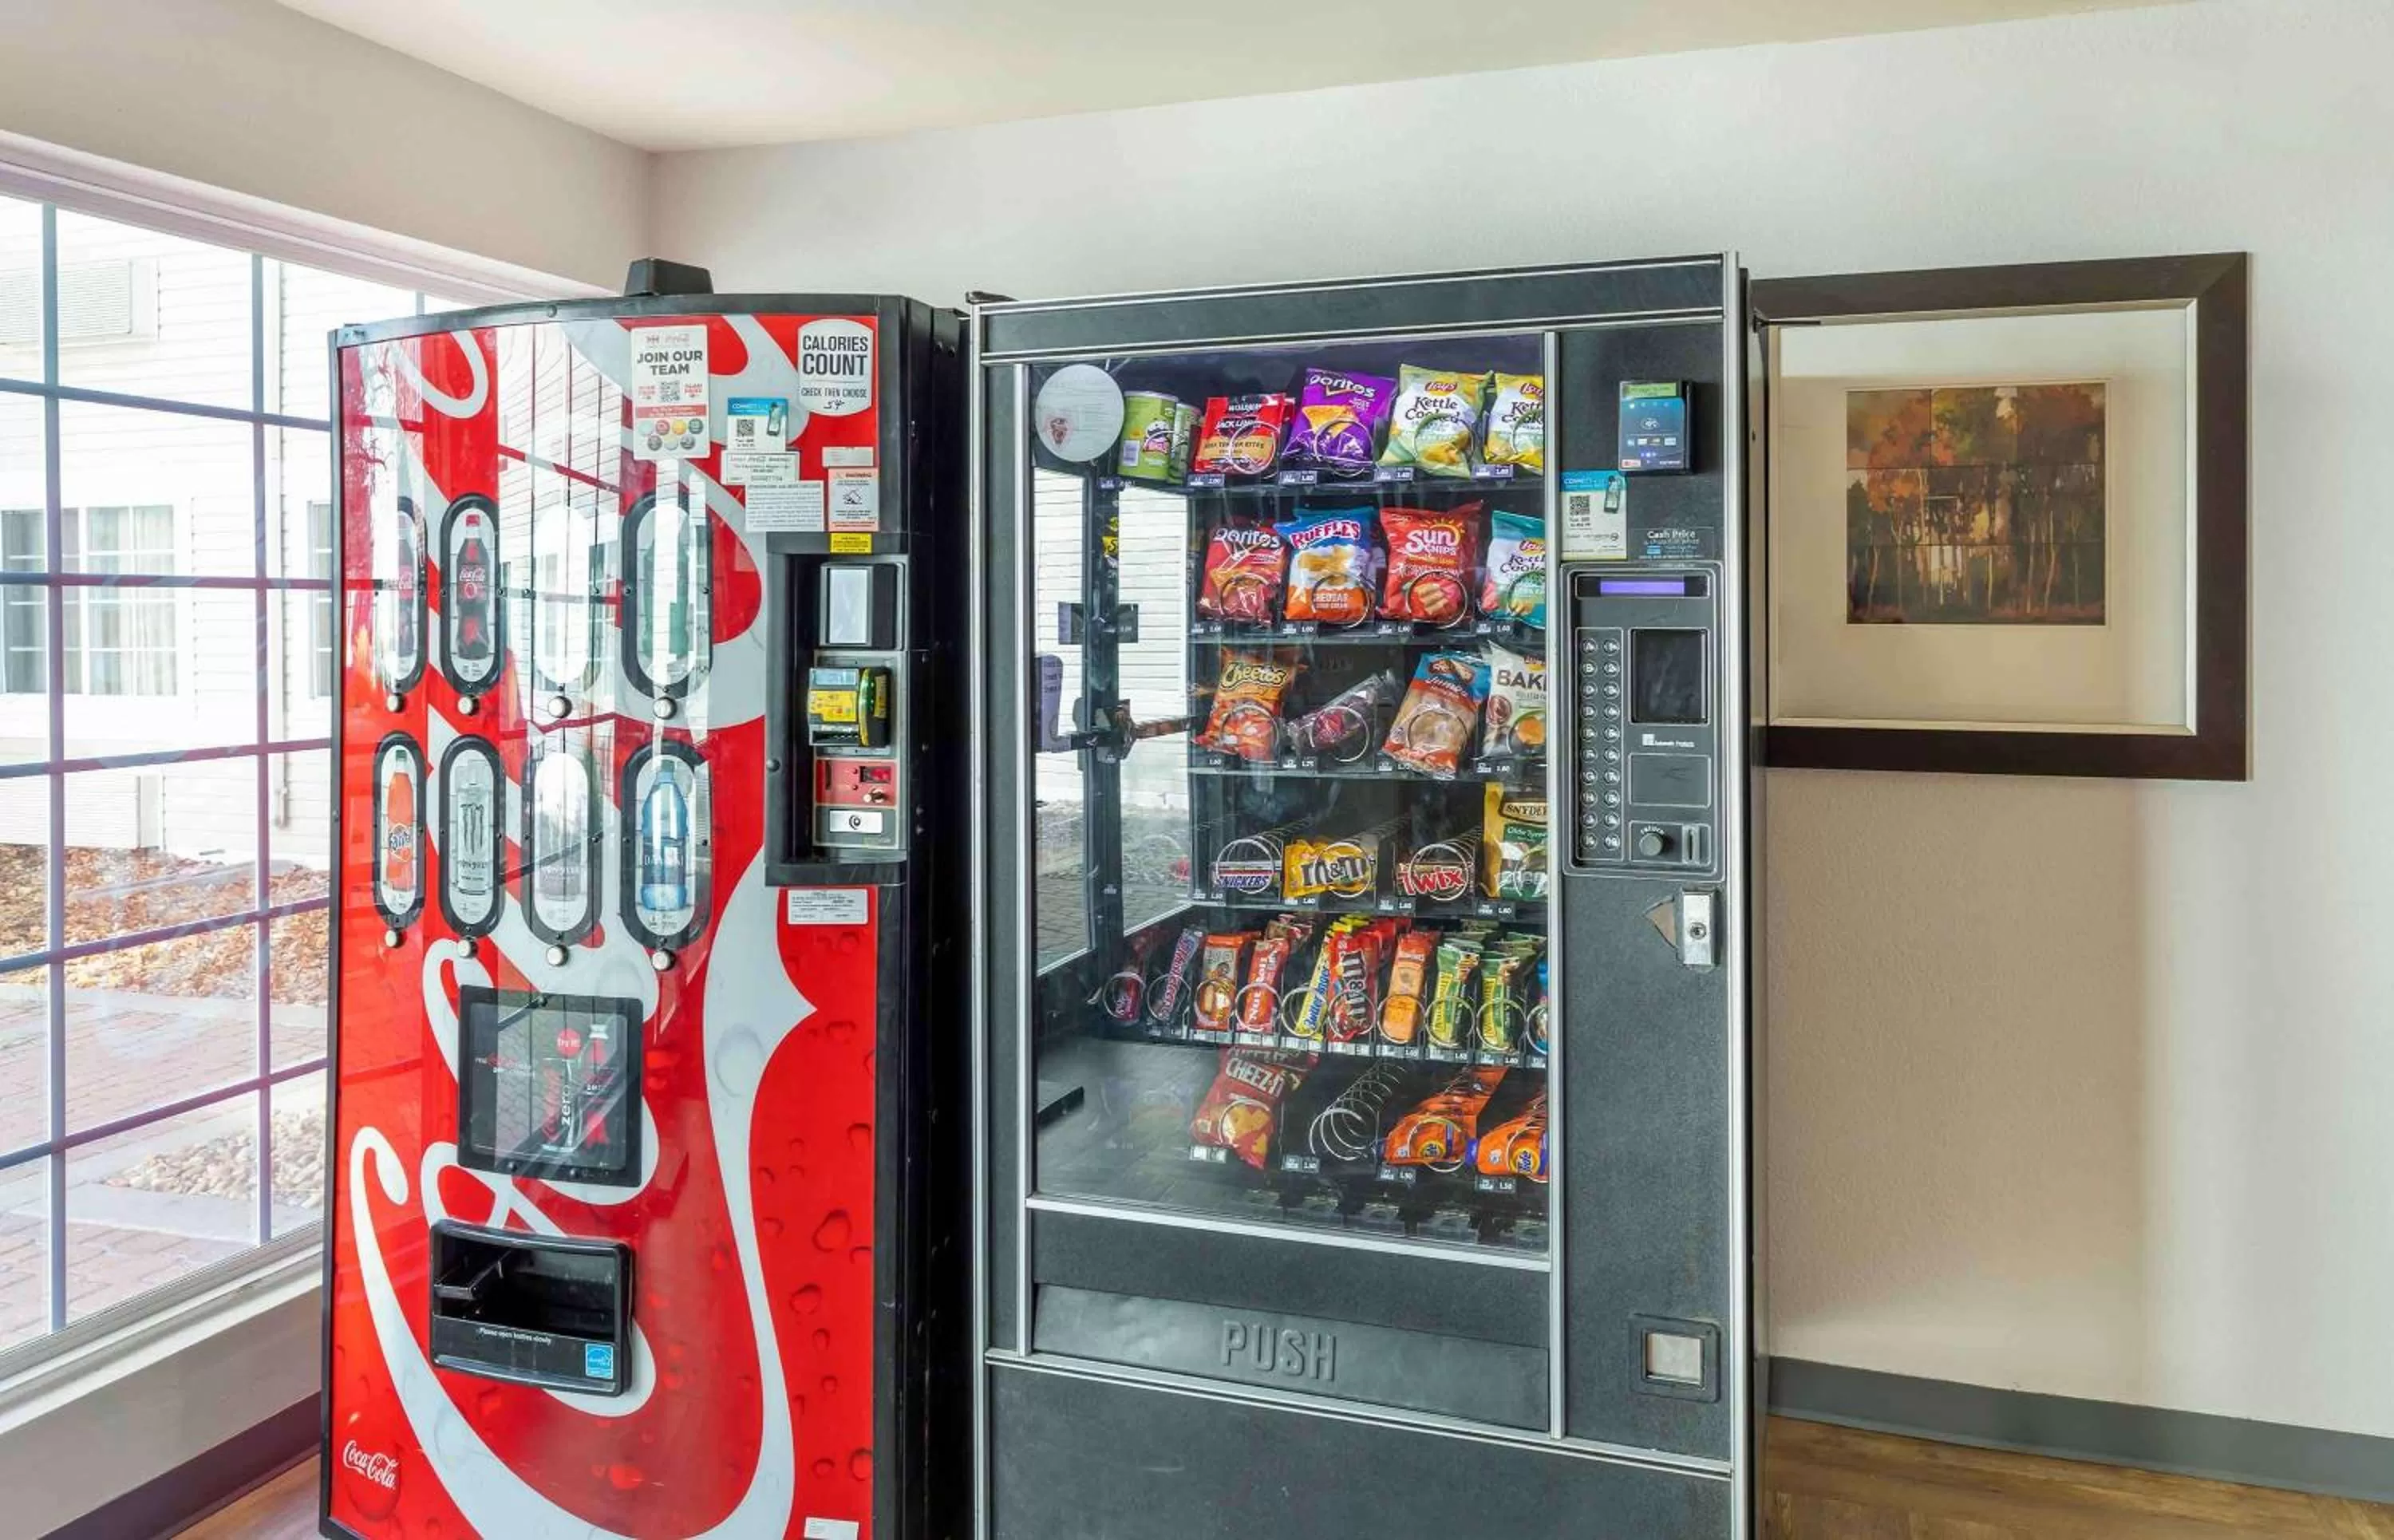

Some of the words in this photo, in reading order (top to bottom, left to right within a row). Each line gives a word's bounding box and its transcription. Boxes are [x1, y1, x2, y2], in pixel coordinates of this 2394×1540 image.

[802, 335, 869, 351] CALORIES
[637, 352, 669, 364] JOIN
[673, 350, 703, 361] OUR
[802, 353, 867, 376] COUNT
[650, 364, 689, 375] TEAM
[800, 387, 822, 397] CHECK
[824, 387, 840, 397] THEN
[843, 388, 867, 397] CHOOSE
[1309, 374, 1377, 398] Doritos
[1414, 397, 1458, 411] Kettle
[1511, 401, 1544, 415] Kett
[1213, 527, 1281, 548] Doritos
[1290, 519, 1361, 549] RUFFLES
[1405, 529, 1456, 553] Sun
[1646, 528, 1670, 539] Cash
[1672, 528, 1697, 539] Price
[1221, 661, 1288, 690] Cheetos
[1218, 876, 1270, 888] SNICKERS
[557, 1038, 571, 1048] Try
[561, 1084, 572, 1125] zero
[479, 1327, 497, 1337] Please
[532, 1336, 552, 1346] slowly
[1220, 1319, 1337, 1382] PUSH
[342, 1439, 399, 1491] Coca-Cola
